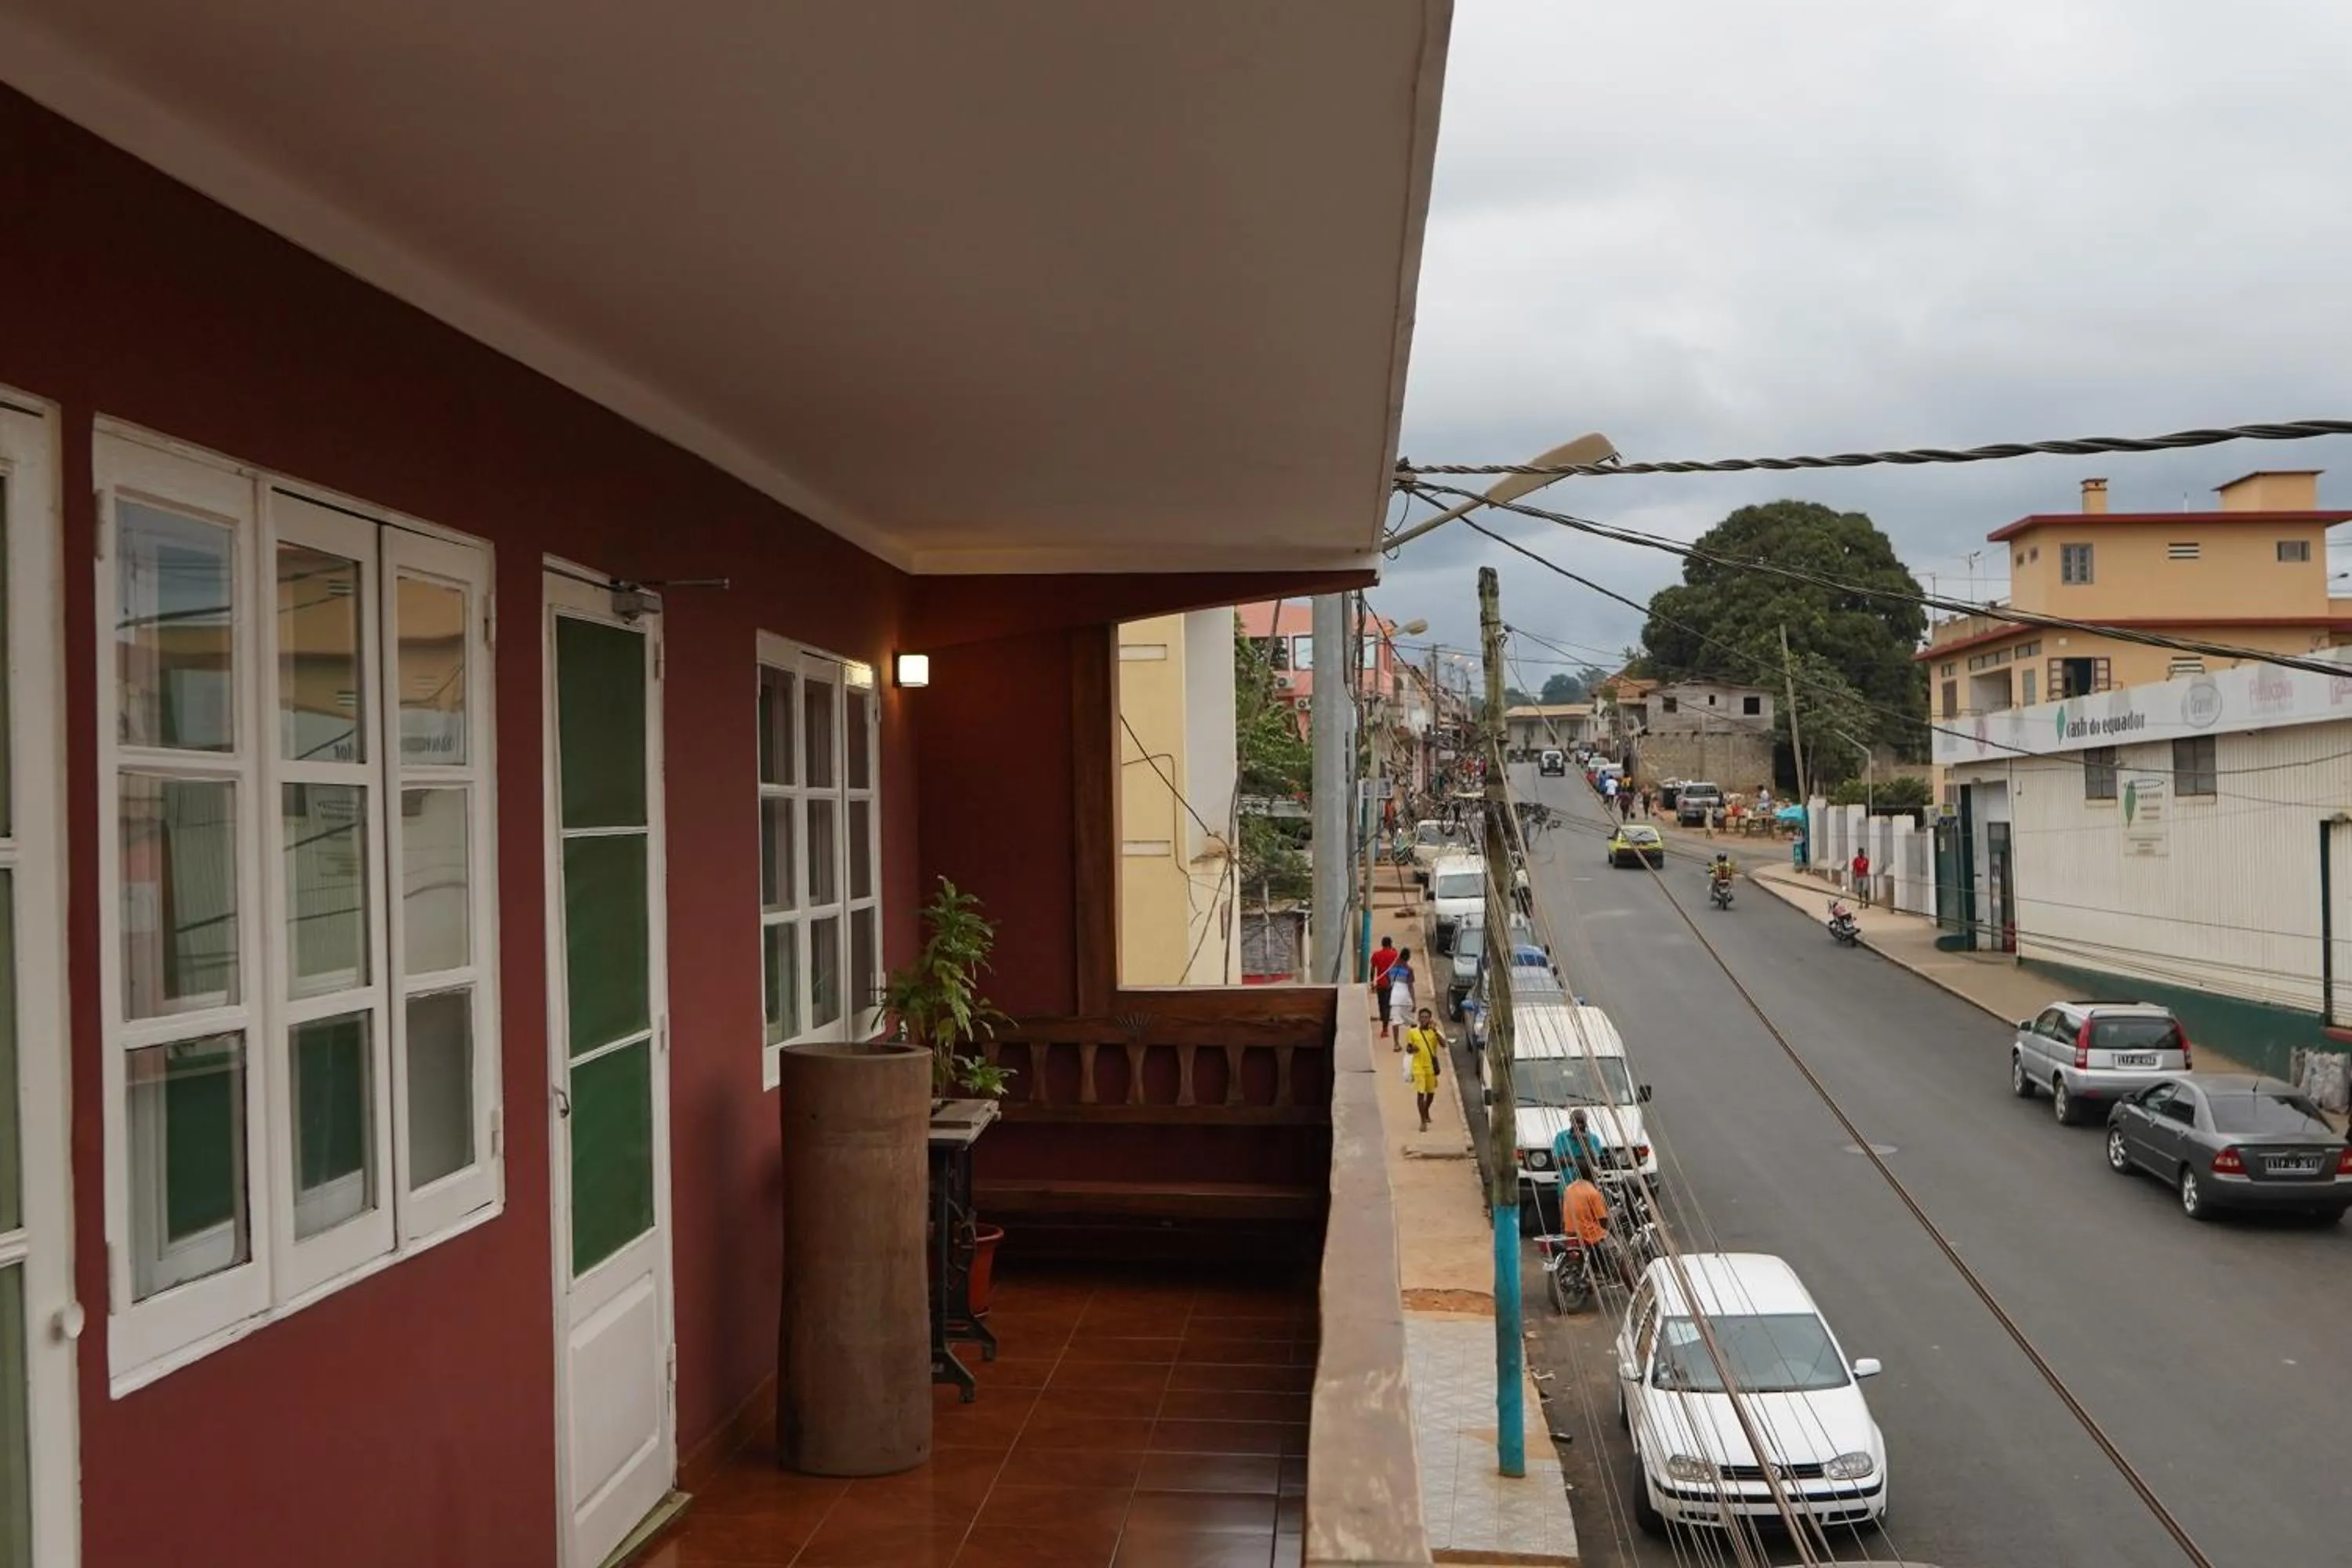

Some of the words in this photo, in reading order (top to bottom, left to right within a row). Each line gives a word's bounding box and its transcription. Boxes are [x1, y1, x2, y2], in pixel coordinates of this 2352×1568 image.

[2067, 717, 2087, 739] cash
[2089, 718, 2100, 735] do
[2102, 710, 2144, 735] equador
